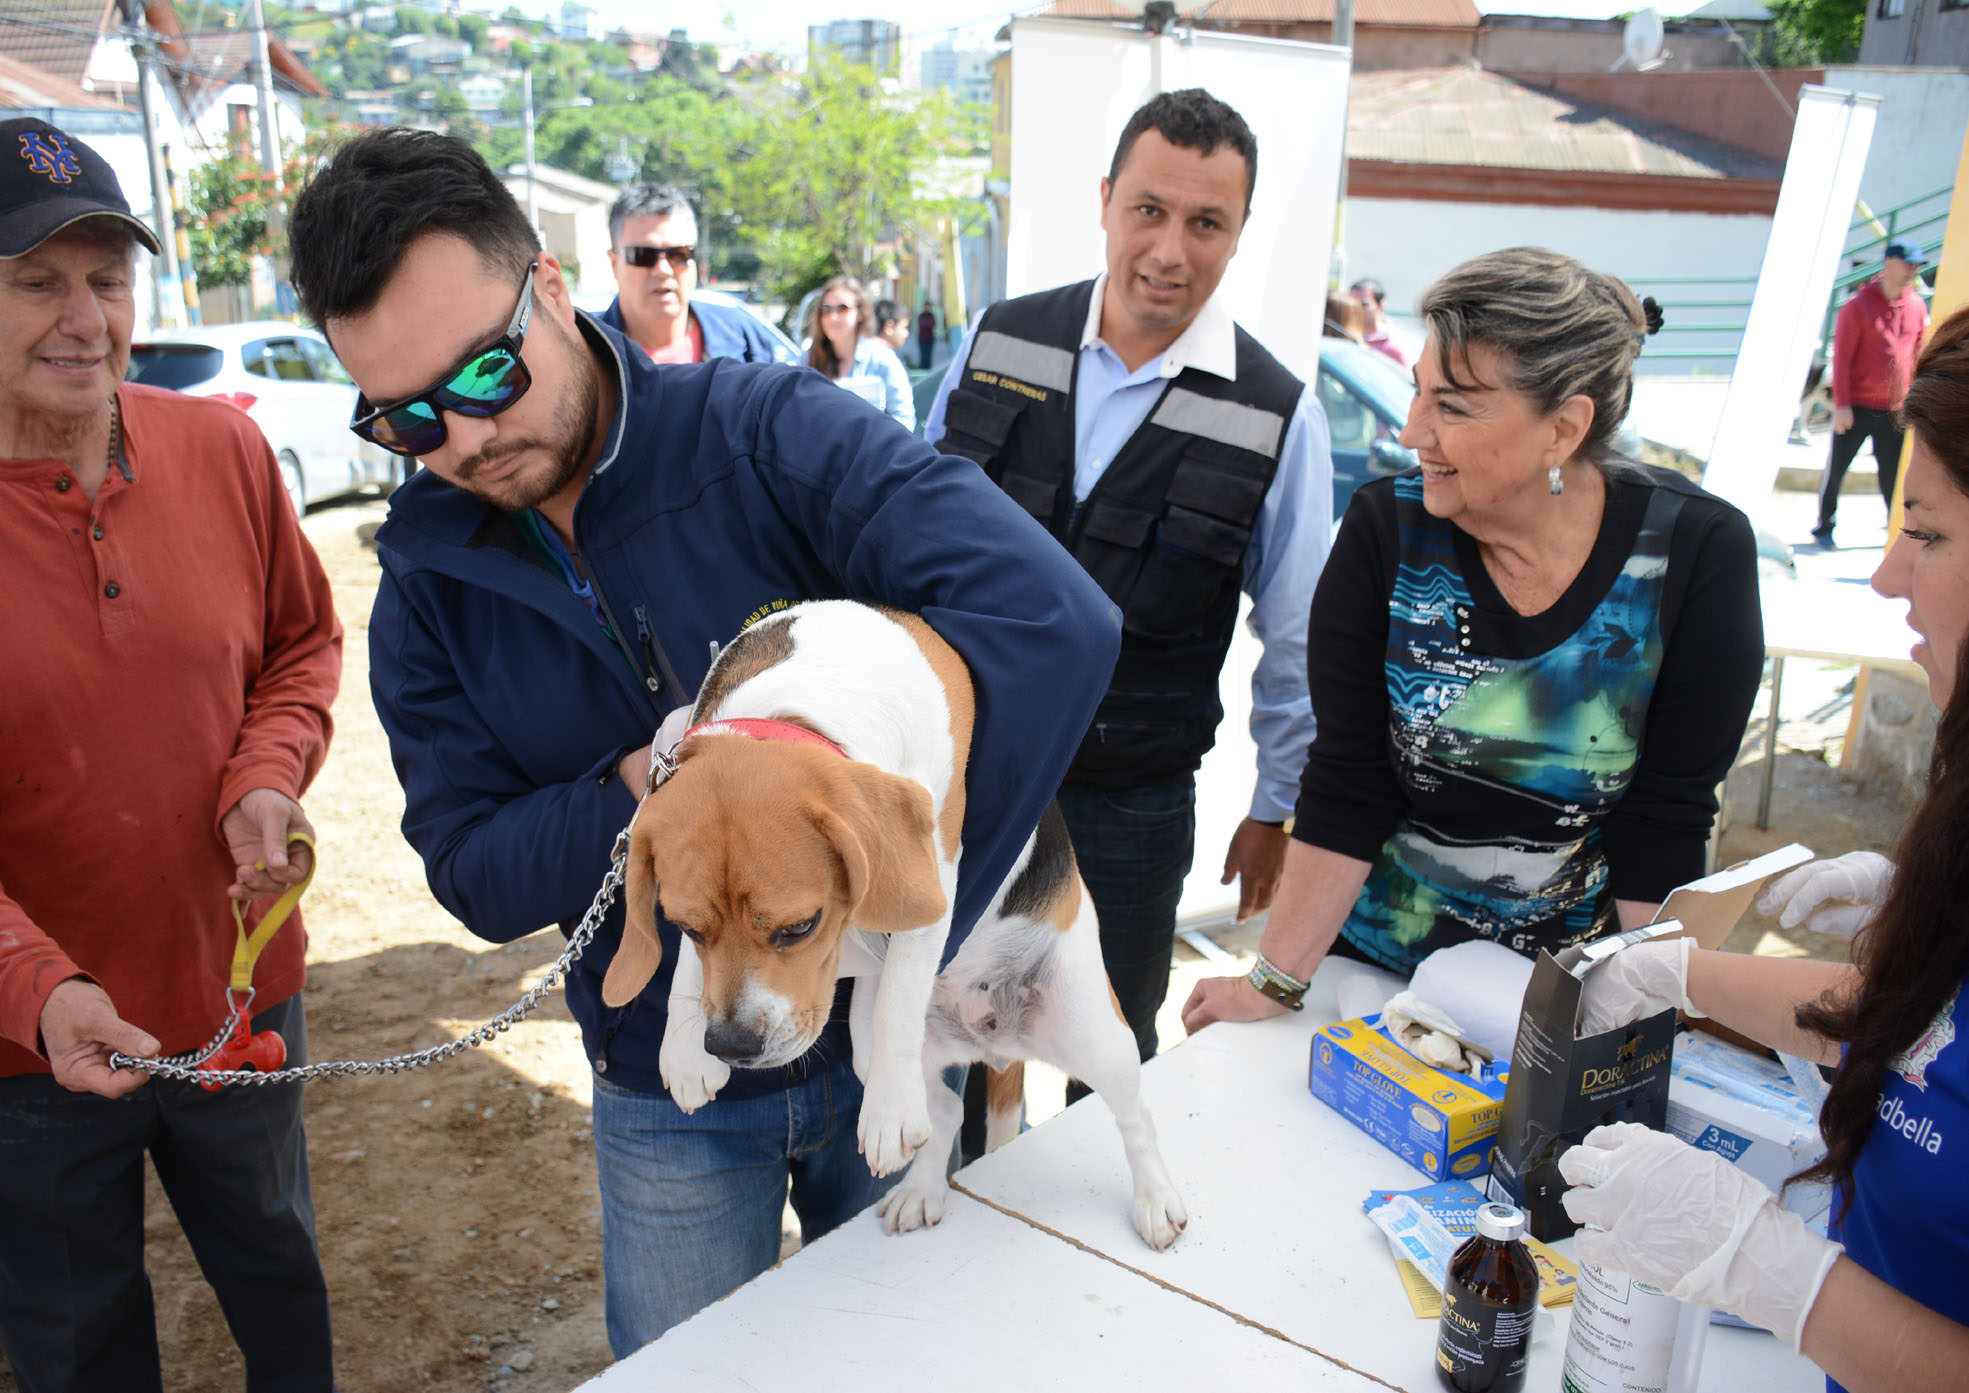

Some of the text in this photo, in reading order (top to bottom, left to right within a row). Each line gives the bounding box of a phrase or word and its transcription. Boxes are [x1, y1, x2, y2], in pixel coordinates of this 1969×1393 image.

[972, 370, 998, 385] CESAR
[759, 604, 771, 616] DE
[1353, 1060, 1372, 1076] TOP
[1370, 1072, 1402, 1098] GLOVE
[1471, 1108, 1494, 1124] TOP
[1708, 1127, 1720, 1143] 3
[1600, 1307, 1631, 1325] General
